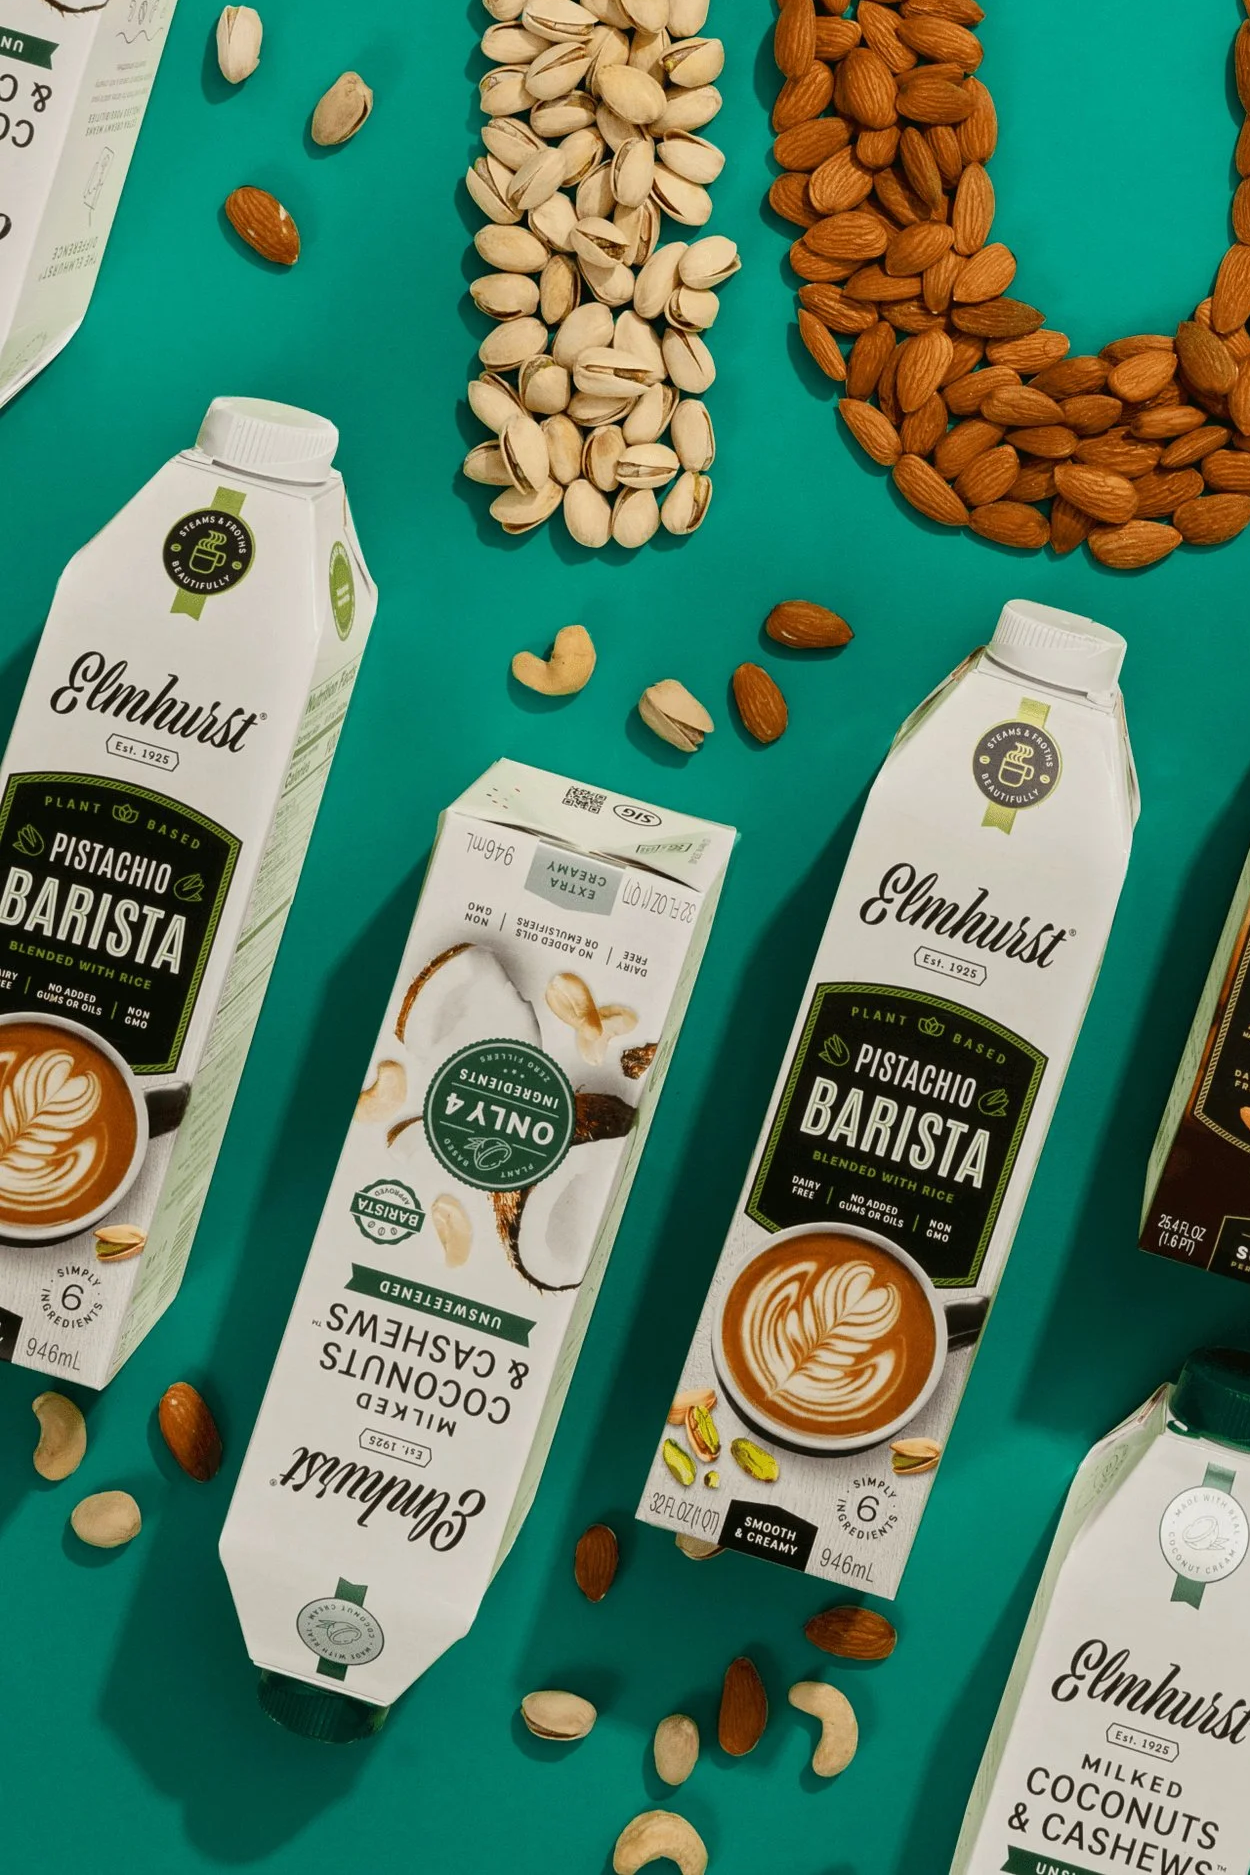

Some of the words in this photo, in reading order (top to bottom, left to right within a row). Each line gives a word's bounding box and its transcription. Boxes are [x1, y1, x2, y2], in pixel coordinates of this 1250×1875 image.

[44, 796, 100, 813] PLANT
[146, 820, 200, 850] BASED
[48, 832, 172, 894] PISTACHIO
[0, 866, 186, 974] BARISTA
[854, 1043, 977, 1108] PISTACHIO
[799, 1076, 990, 1188] BARISTA
[791, 1175, 820, 1190] DAIRY
[791, 1186, 815, 1199] FREE
[359, 1197, 419, 1226] BARISTA
[838, 1200, 866, 1216] GUMS
[866, 1209, 881, 1220] OR
[882, 1214, 904, 1228] OILS
[850, 1194, 865, 1205] NO
[865, 1199, 898, 1215] ADDED
[925, 1228, 949, 1242] GMO
[929, 1219, 952, 1233] NON
[1230, 1261, 1250, 1272] PER
[378, 1279, 502, 1330] UNSWEETENED
[24, 1338, 79, 1371] 946mL
[318, 1342, 511, 1424] COCONUTS
[508, 1358, 529, 1388] &
[356, 1392, 457, 1437] MILKED
[734, 1528, 743, 1538] &
[746, 1531, 797, 1555] CREAMY
[743, 1515, 797, 1542] SMOOTH
[1114, 1730, 1137, 1745] Est.
[1141, 1738, 1170, 1755] 1925
[1080, 1753, 1182, 1798] MILKED
[1008, 1803, 1029, 1833] &
[1026, 1767, 1220, 1848] COCONUTS
